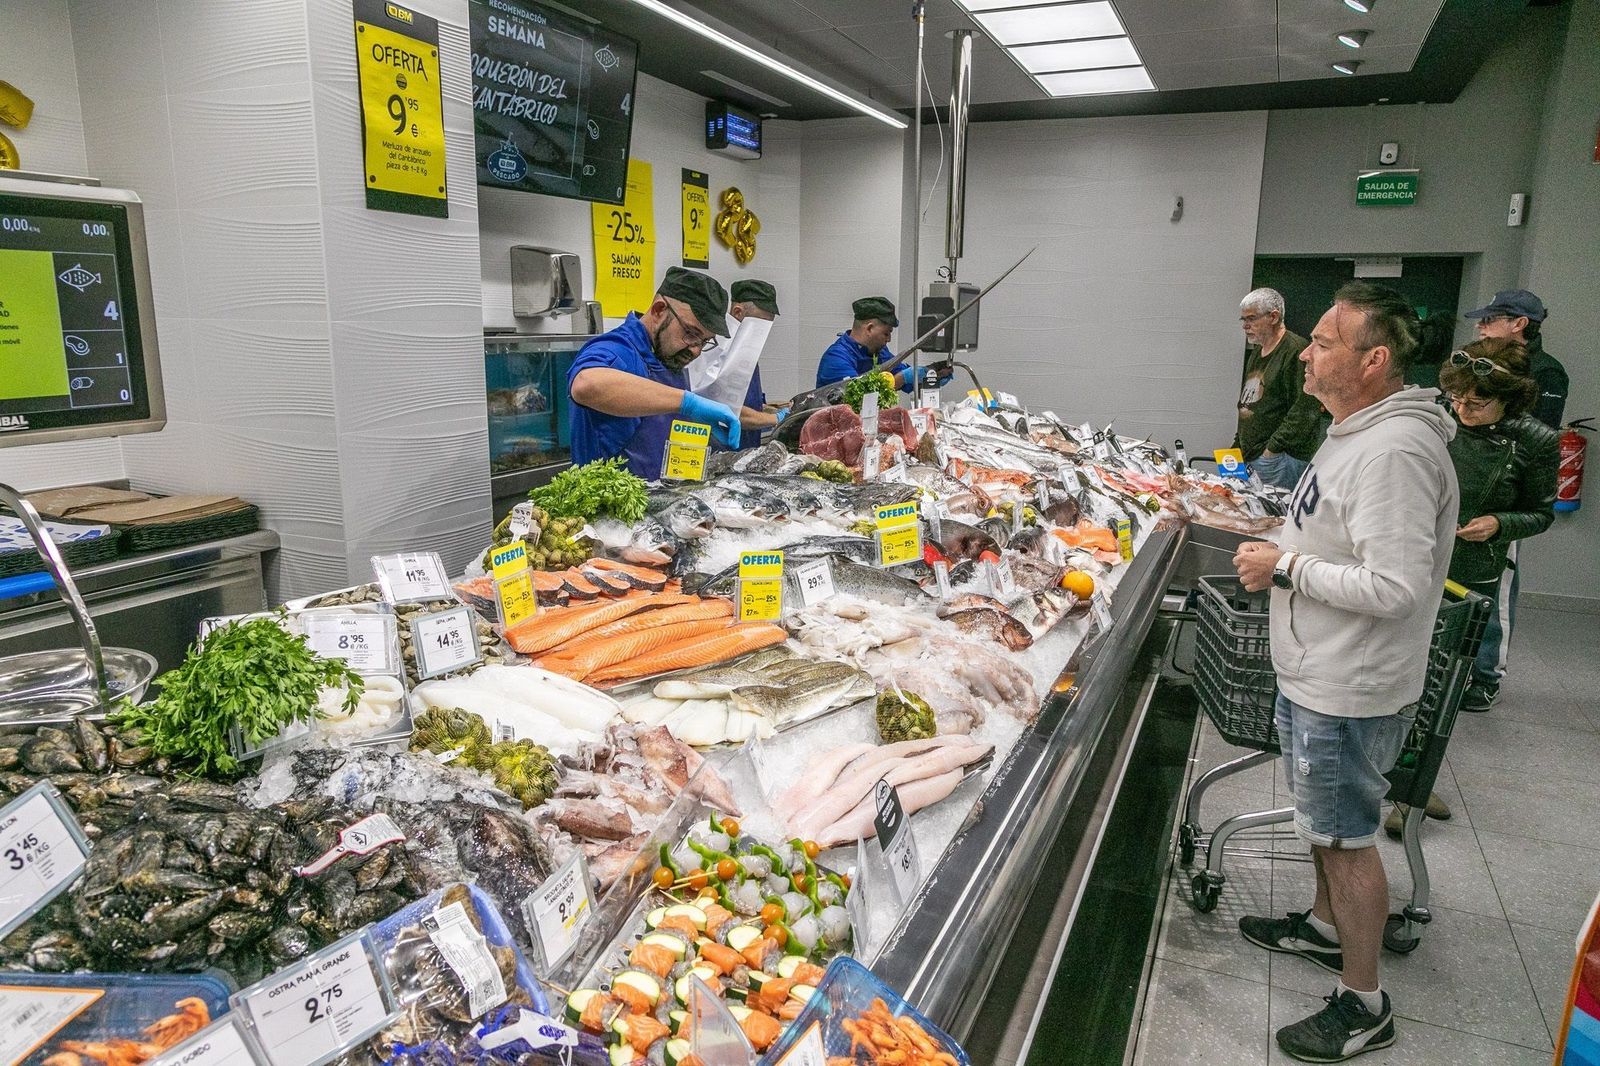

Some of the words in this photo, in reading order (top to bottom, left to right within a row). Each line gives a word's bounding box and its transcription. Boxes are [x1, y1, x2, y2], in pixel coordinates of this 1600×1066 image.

[398, 8, 412, 22] BM
[488, 15, 546, 49] SEMANA
[372, 44, 428, 82] OFERTA
[538, 74, 567, 99] DEL
[621, 93, 631, 116] 4
[382, 141, 403, 151] Merluza
[404, 145, 411, 153] de
[412, 147, 432, 157] anzuelo
[388, 152, 397, 160] del
[386, 161, 401, 169] pieza
[492, 168, 520, 180] PESCADO
[1364, 182, 1395, 190] SALIDA
[1397, 182, 1409, 190] DE
[1357, 191, 1414, 200] EMERGENCIA
[2, 218, 28, 231] 0,00
[82, 223, 106, 236] 0,00
[606, 211, 645, 245] -25%
[611, 252, 642, 266] SALMÓN
[612, 267, 640, 279] FRESCO
[104, 300, 119, 321] 4
[115, 352, 123, 364] 1
[120, 389, 129, 401] 0
[673, 424, 708, 437] OFERTA
[878, 505, 915, 519] OFERTA
[493, 546, 525, 566] OFERTA
[742, 554, 781, 565] OFERTA
[268, 981, 296, 998] OSTRA
[296, 968, 322, 985] PLANA
[322, 951, 351, 971] GRANDE
[182, 1043, 211, 1064] GORDO
